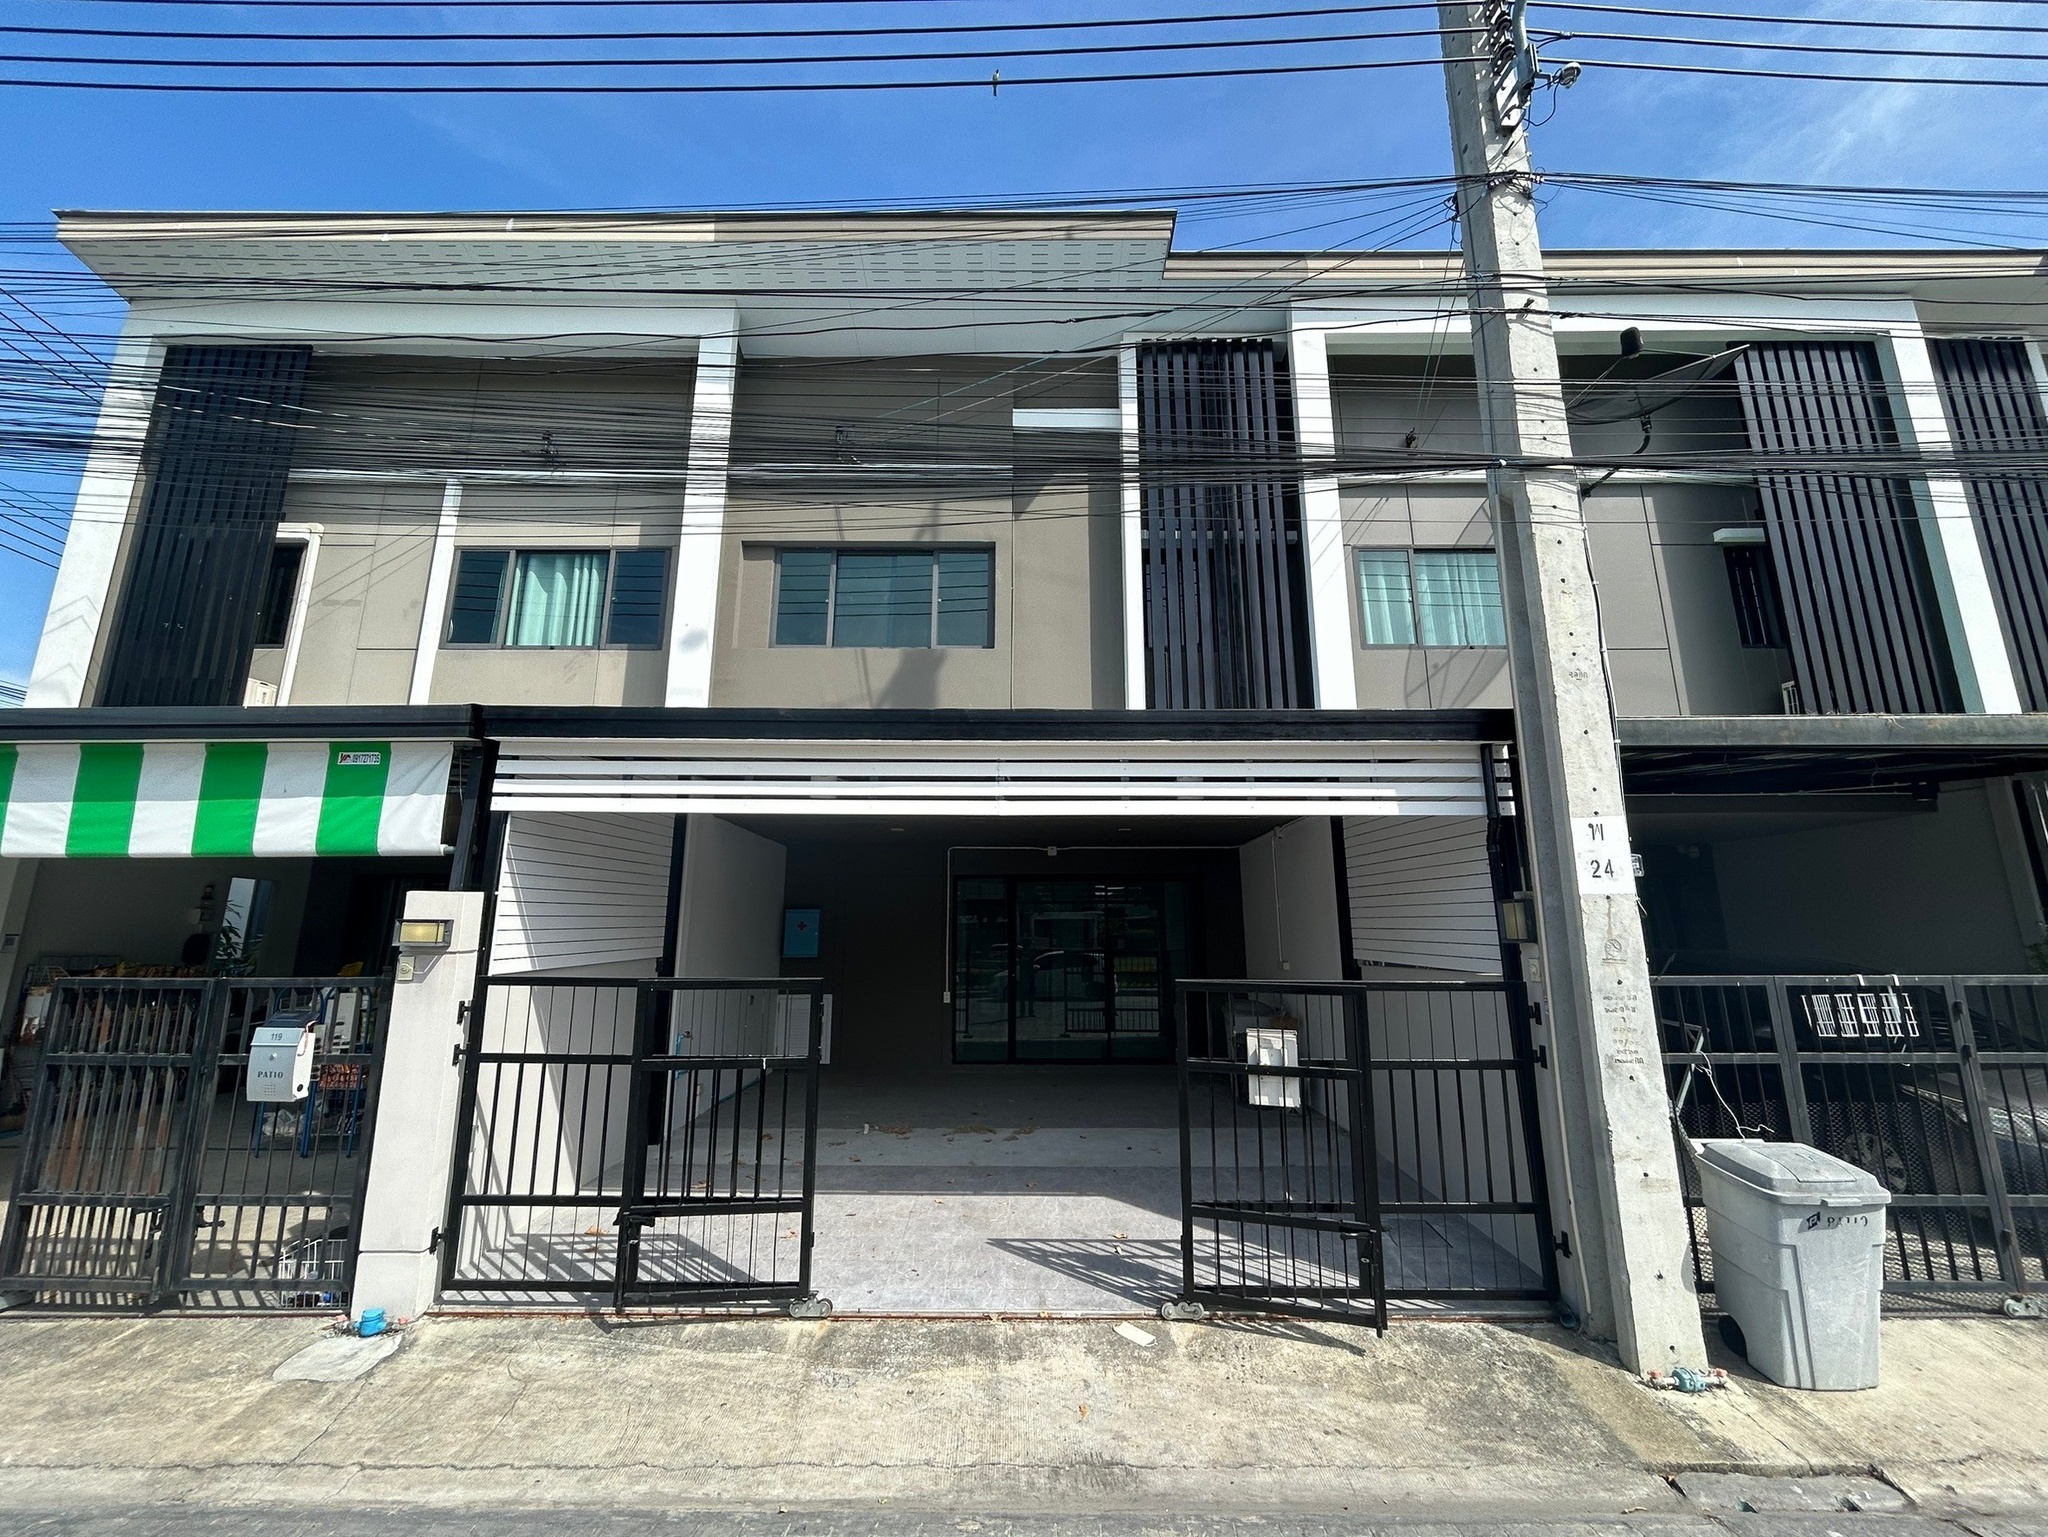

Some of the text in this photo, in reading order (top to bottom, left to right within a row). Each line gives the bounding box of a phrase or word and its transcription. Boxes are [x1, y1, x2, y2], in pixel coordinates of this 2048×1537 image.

[1590, 859, 1615, 879] 24
[270, 1032, 283, 1041] 119
[257, 1070, 284, 1079] PATIO
